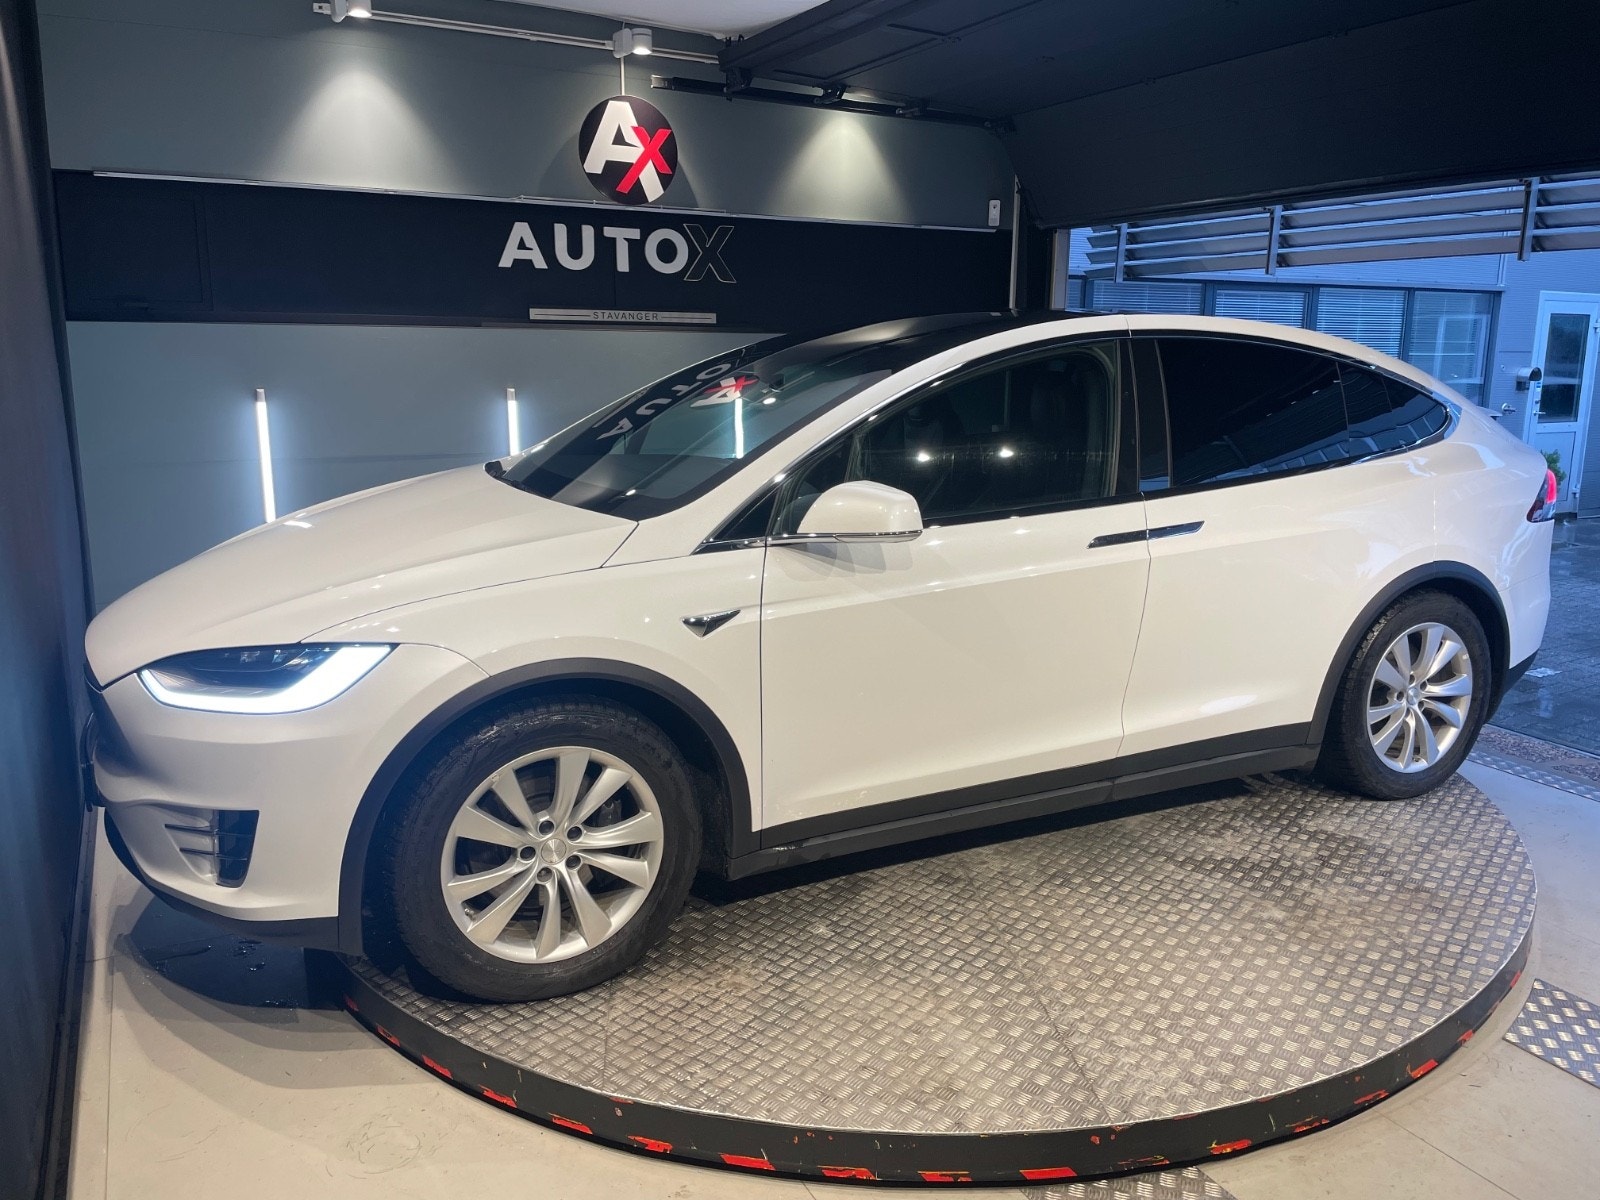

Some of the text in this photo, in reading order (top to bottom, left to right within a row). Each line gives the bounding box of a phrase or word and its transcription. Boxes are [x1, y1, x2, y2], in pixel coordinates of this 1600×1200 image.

[583, 100, 673, 203] AX
[498, 221, 737, 283] AUTOX
[592, 311, 659, 321] STAVANGER
